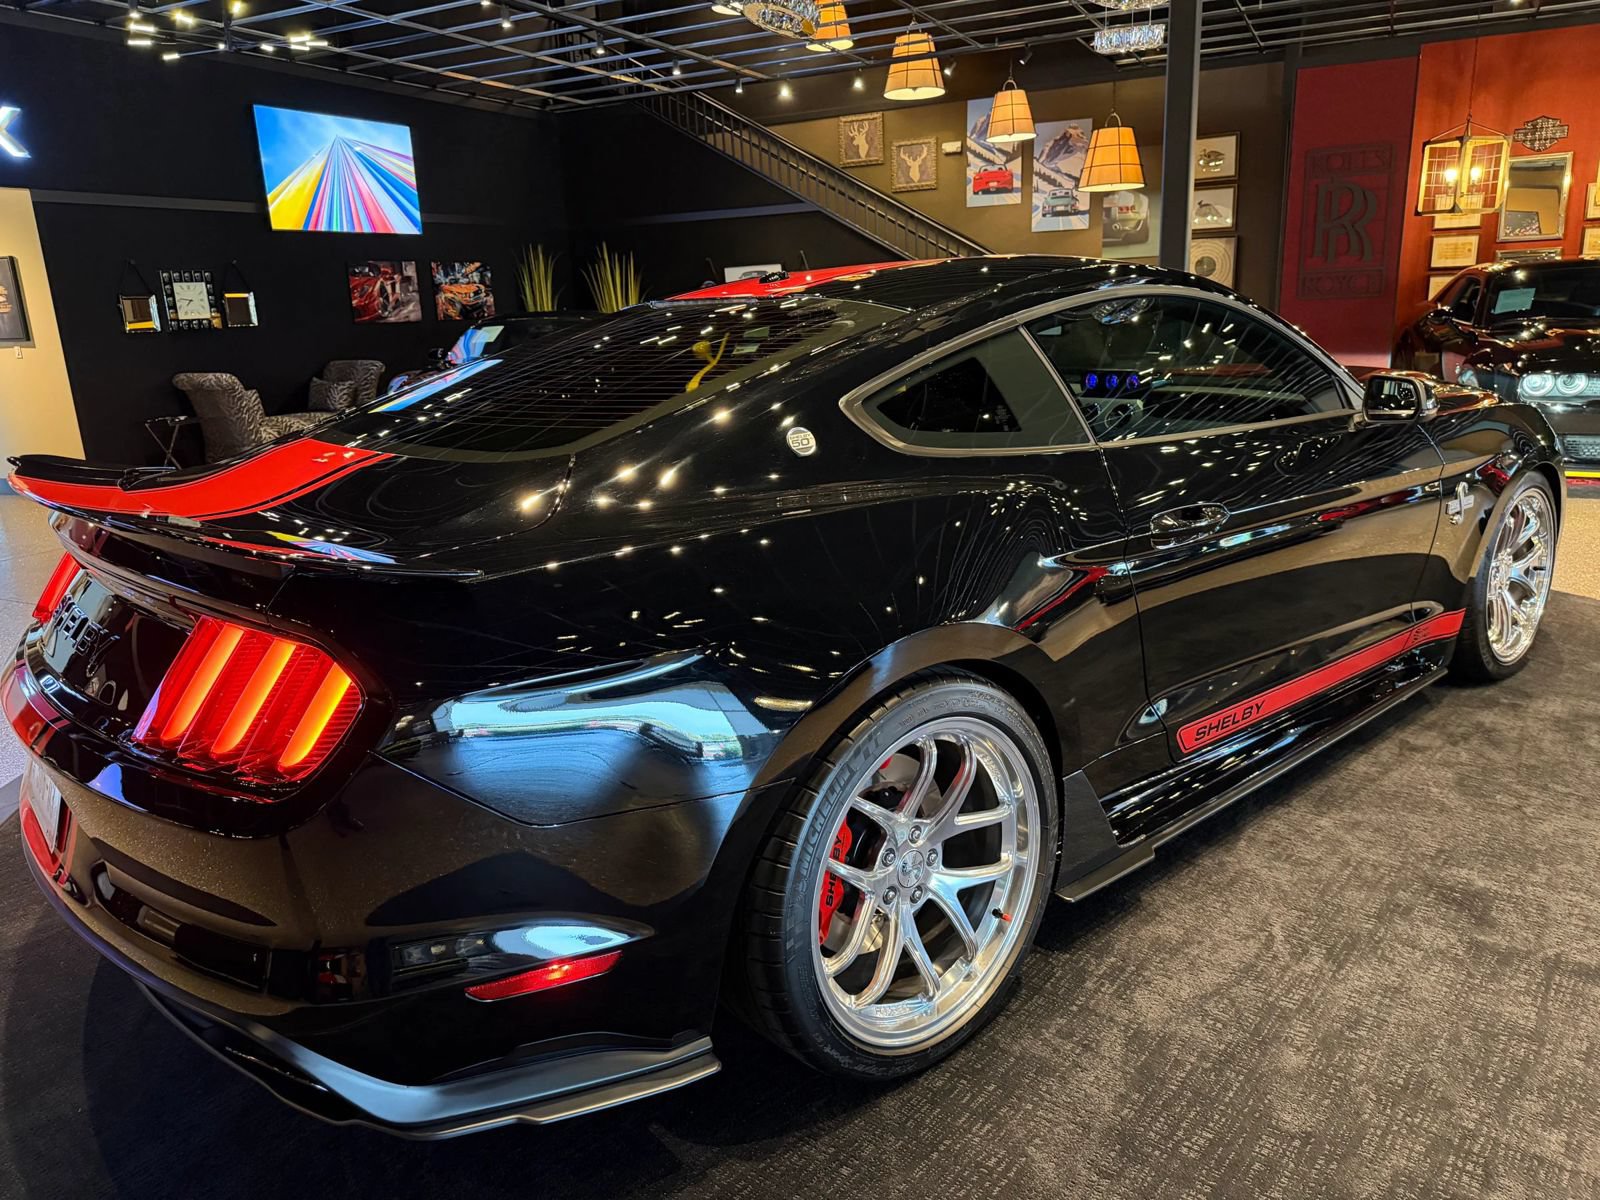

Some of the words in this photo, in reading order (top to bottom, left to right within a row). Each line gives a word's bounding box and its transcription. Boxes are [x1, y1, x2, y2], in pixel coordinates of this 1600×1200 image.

[1194, 699, 1265, 742] SHELBY
[800, 764, 851, 876] MICHELIN
[825, 834, 842, 907] SHEBY
